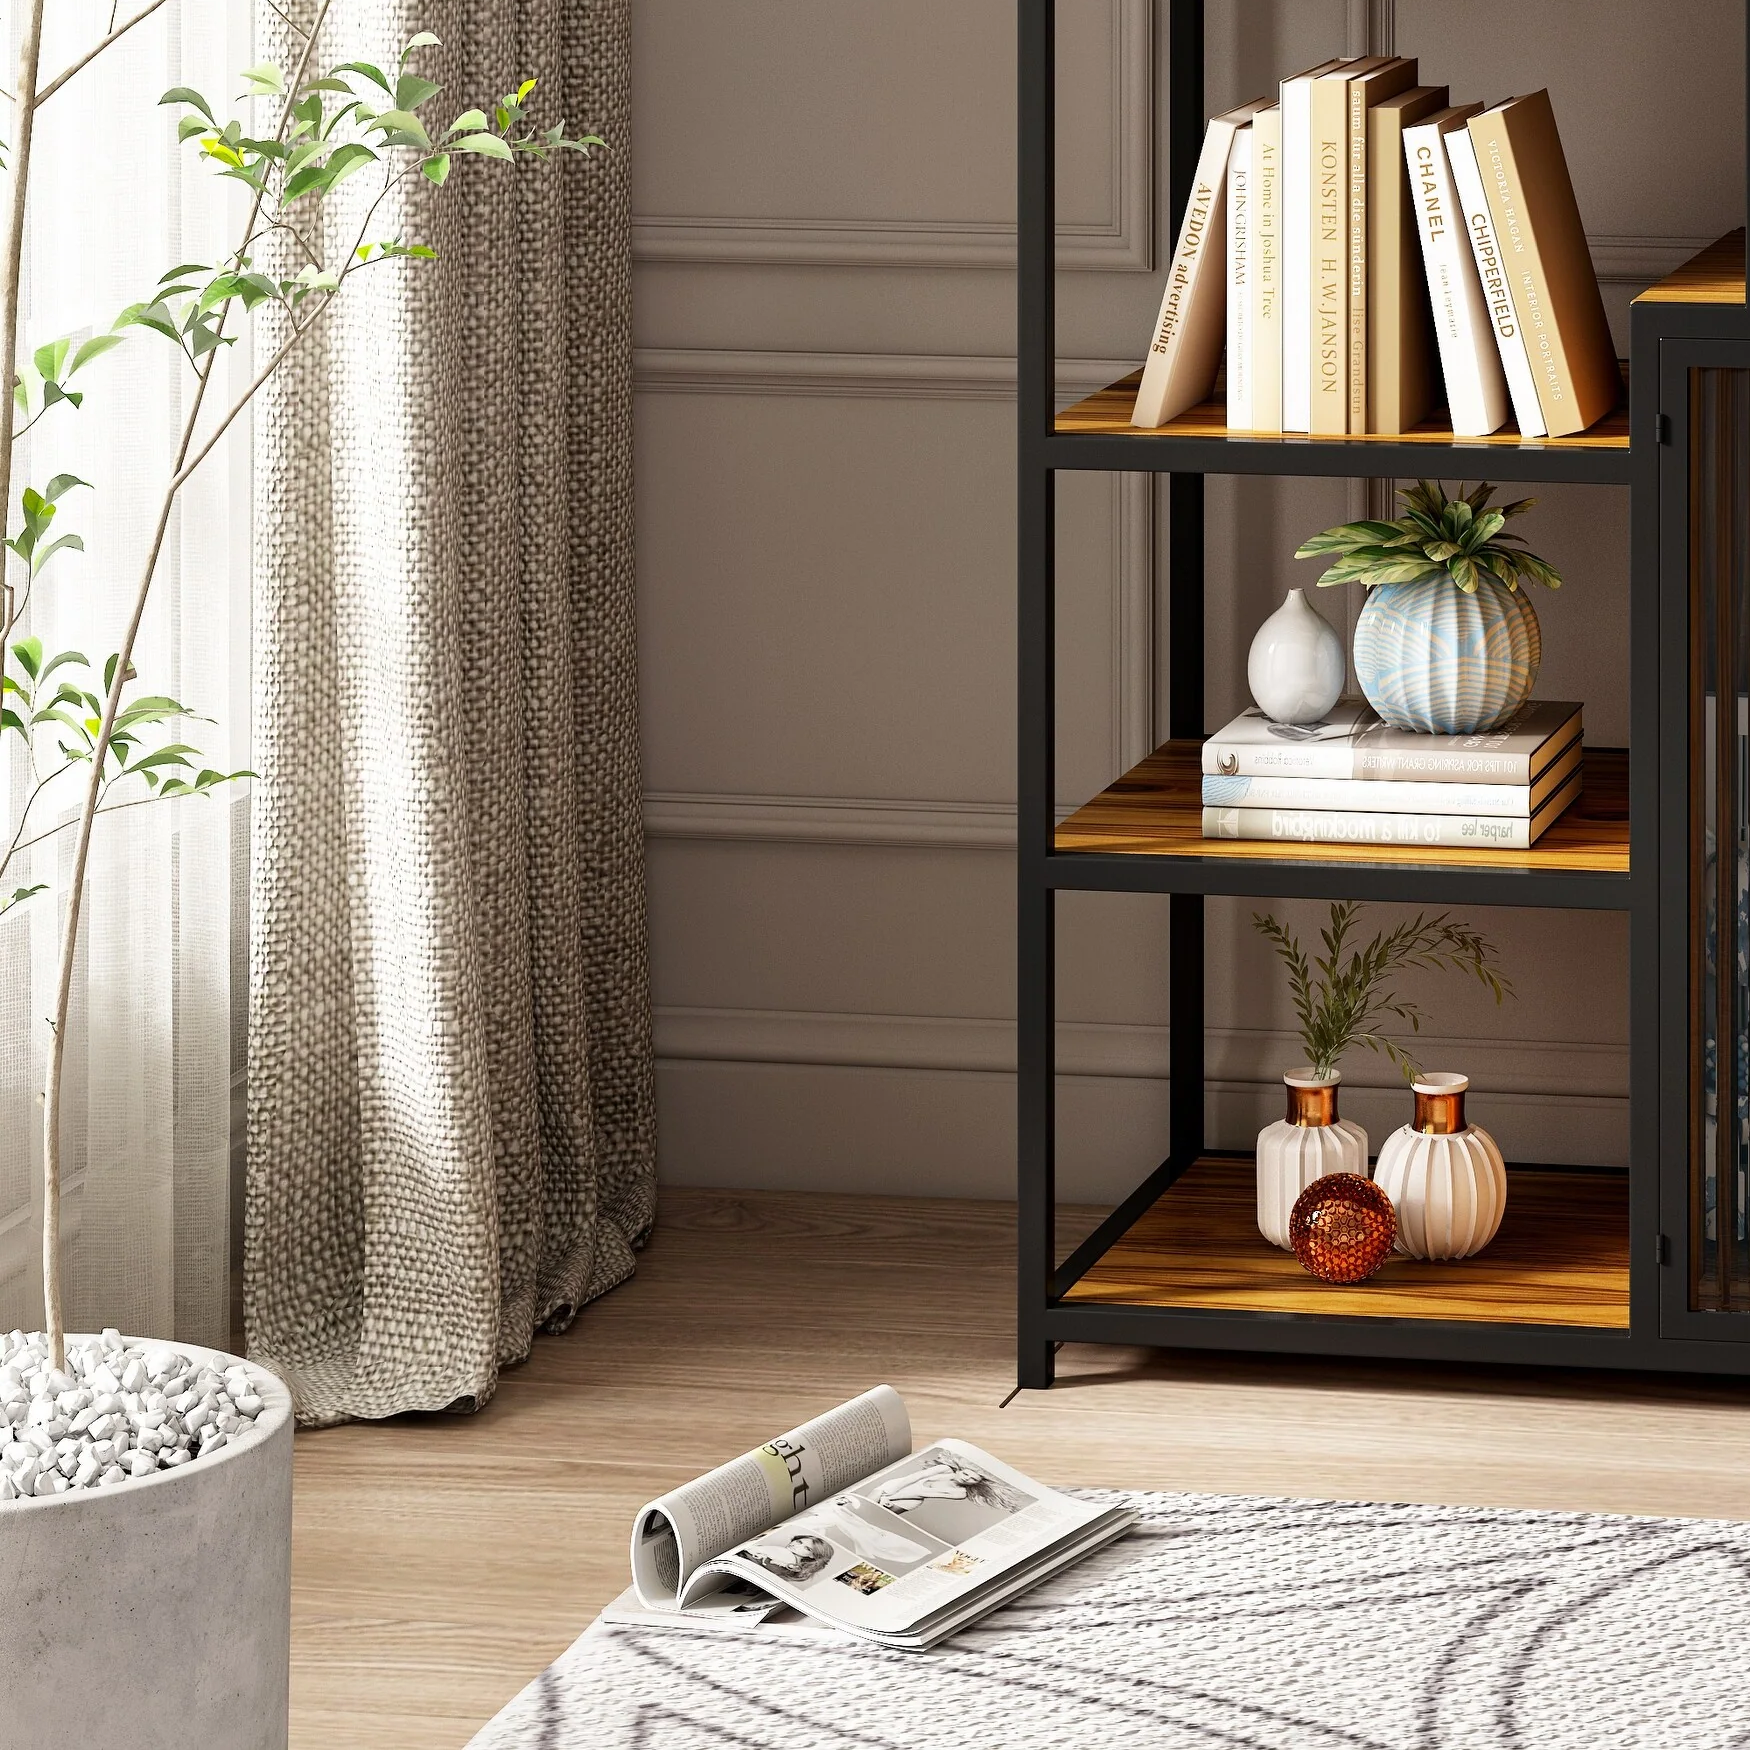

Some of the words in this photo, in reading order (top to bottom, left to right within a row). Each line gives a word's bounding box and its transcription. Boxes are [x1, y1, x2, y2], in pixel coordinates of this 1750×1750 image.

[1352, 91, 1362, 130] saum
[1263, 143, 1275, 161] At
[1352, 136, 1365, 160] für
[1263, 166, 1275, 209] Home
[1321, 141, 1337, 241] KONSTEN
[1352, 165, 1365, 192] alla
[1417, 147, 1444, 242] CHANEL
[1182, 182, 1212, 261] AVEDON
[1263, 213, 1275, 227] in
[1352, 198, 1365, 222] die
[1259, 231, 1275, 282] Joshua
[1352, 227, 1365, 296] sünderin
[1439, 264, 1450, 287] Jean
[1472, 213, 1515, 338] CHIPPERFIELD
[1487, 139, 1512, 204] VICTORIA
[1503, 208, 1525, 253] HAGAN
[1521, 271, 1544, 329] INTERIOR
[1538, 334, 1564, 402] PORTRAITS
[1152, 264, 1188, 355] advertising
[1263, 287, 1275, 319] Tree
[1352, 308, 1365, 334] lise
[1442, 290, 1458, 339] Leymarie
[1352, 340, 1365, 414] Grandsun
[762, 1439, 810, 1510] ght
